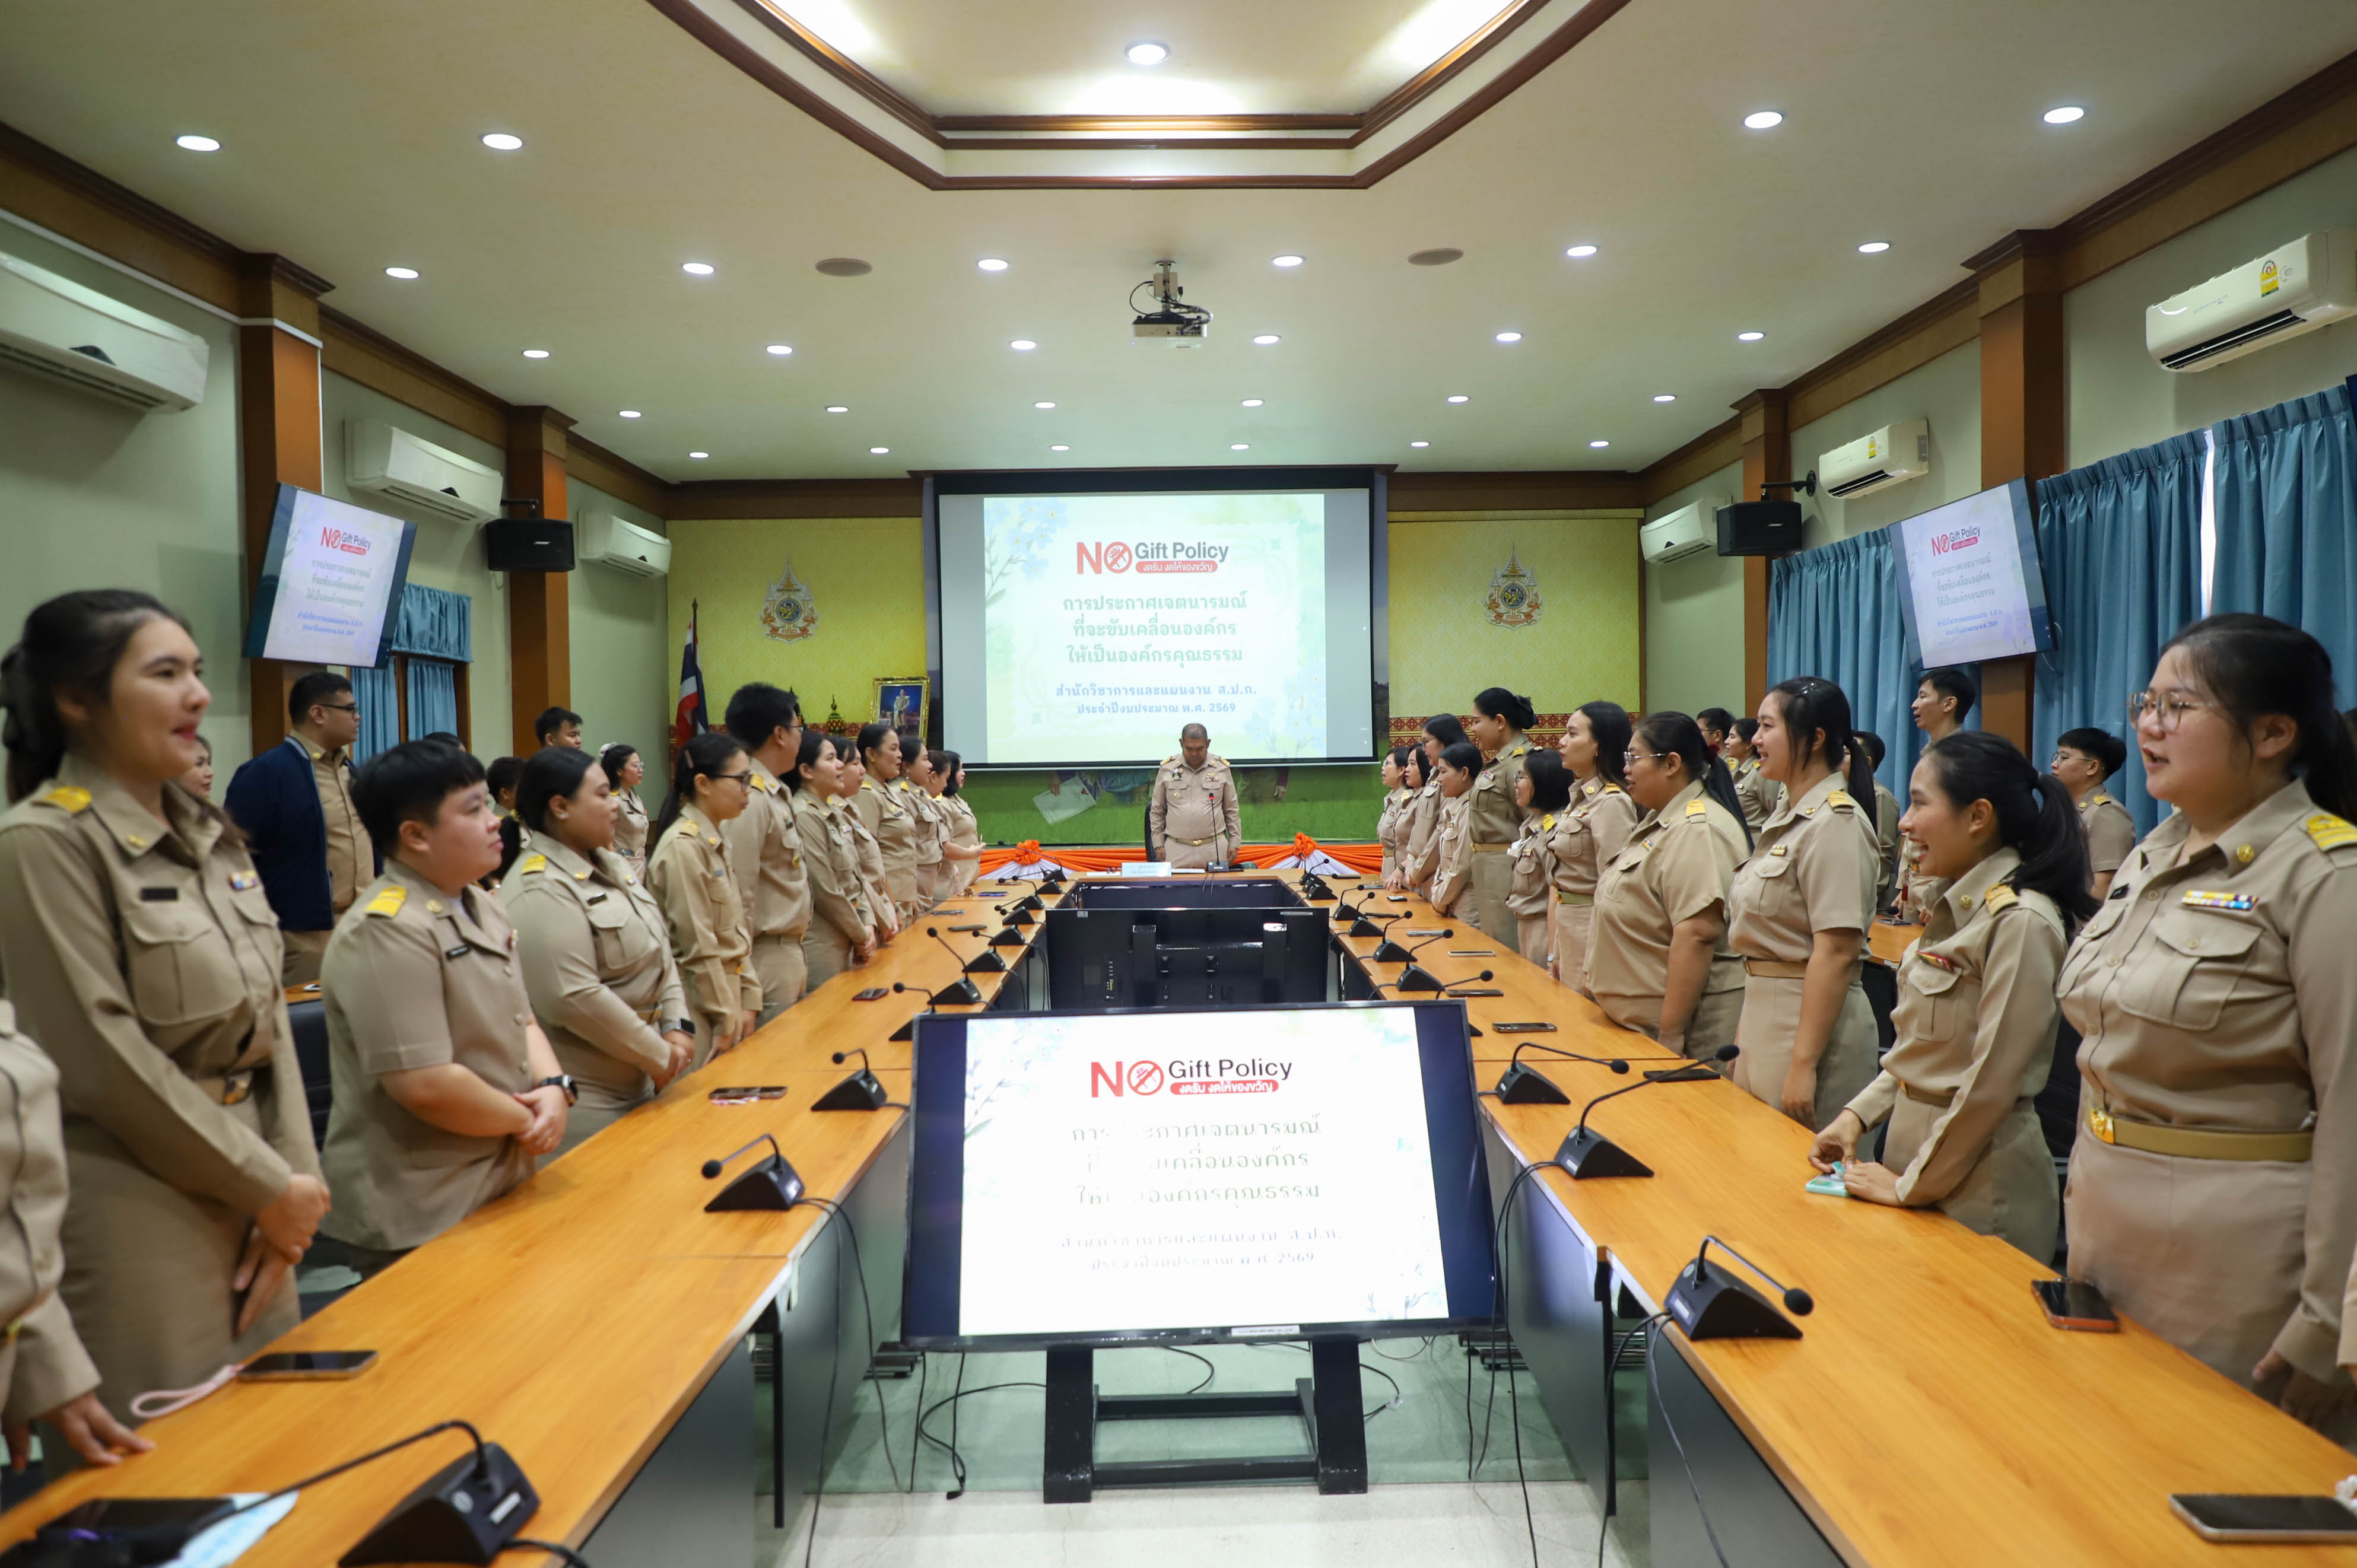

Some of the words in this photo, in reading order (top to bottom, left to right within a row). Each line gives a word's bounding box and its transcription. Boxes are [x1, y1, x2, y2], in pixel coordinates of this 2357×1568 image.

[1949, 530, 1961, 542] Gift
[1961, 526, 1980, 539] Policy
[1135, 542, 1168, 559] Gift
[1173, 542, 1229, 562] Policy
[1143, 562, 1162, 571] งดรับ
[1164, 561, 1213, 572] งดให้ของขวัญ
[1063, 590, 1248, 610] การประกาศเจตนารมณ์
[1073, 612, 1237, 637] ที่จะขับเคลื่อนองค์กร
[1066, 643, 1243, 669] ให้เป็นองค์กรคุณธรรม
[1056, 683, 1211, 696] สำนักวิชาการและแผนงาน
[1218, 683, 1257, 695] ส.ป.ก.
[1077, 701, 1179, 714] ประจำปีงบประมาณ
[1181, 704, 1206, 713] พ.ศ.
[1208, 702, 1237, 713] 2569
[1168, 1060, 1212, 1079] Gift
[1219, 1058, 1292, 1080] Policy
[1179, 1082, 1206, 1095] งดรับ
[1208, 1080, 1273, 1095] งดให้ของขวัญ
[1277, 1252, 1316, 1264] 2569
